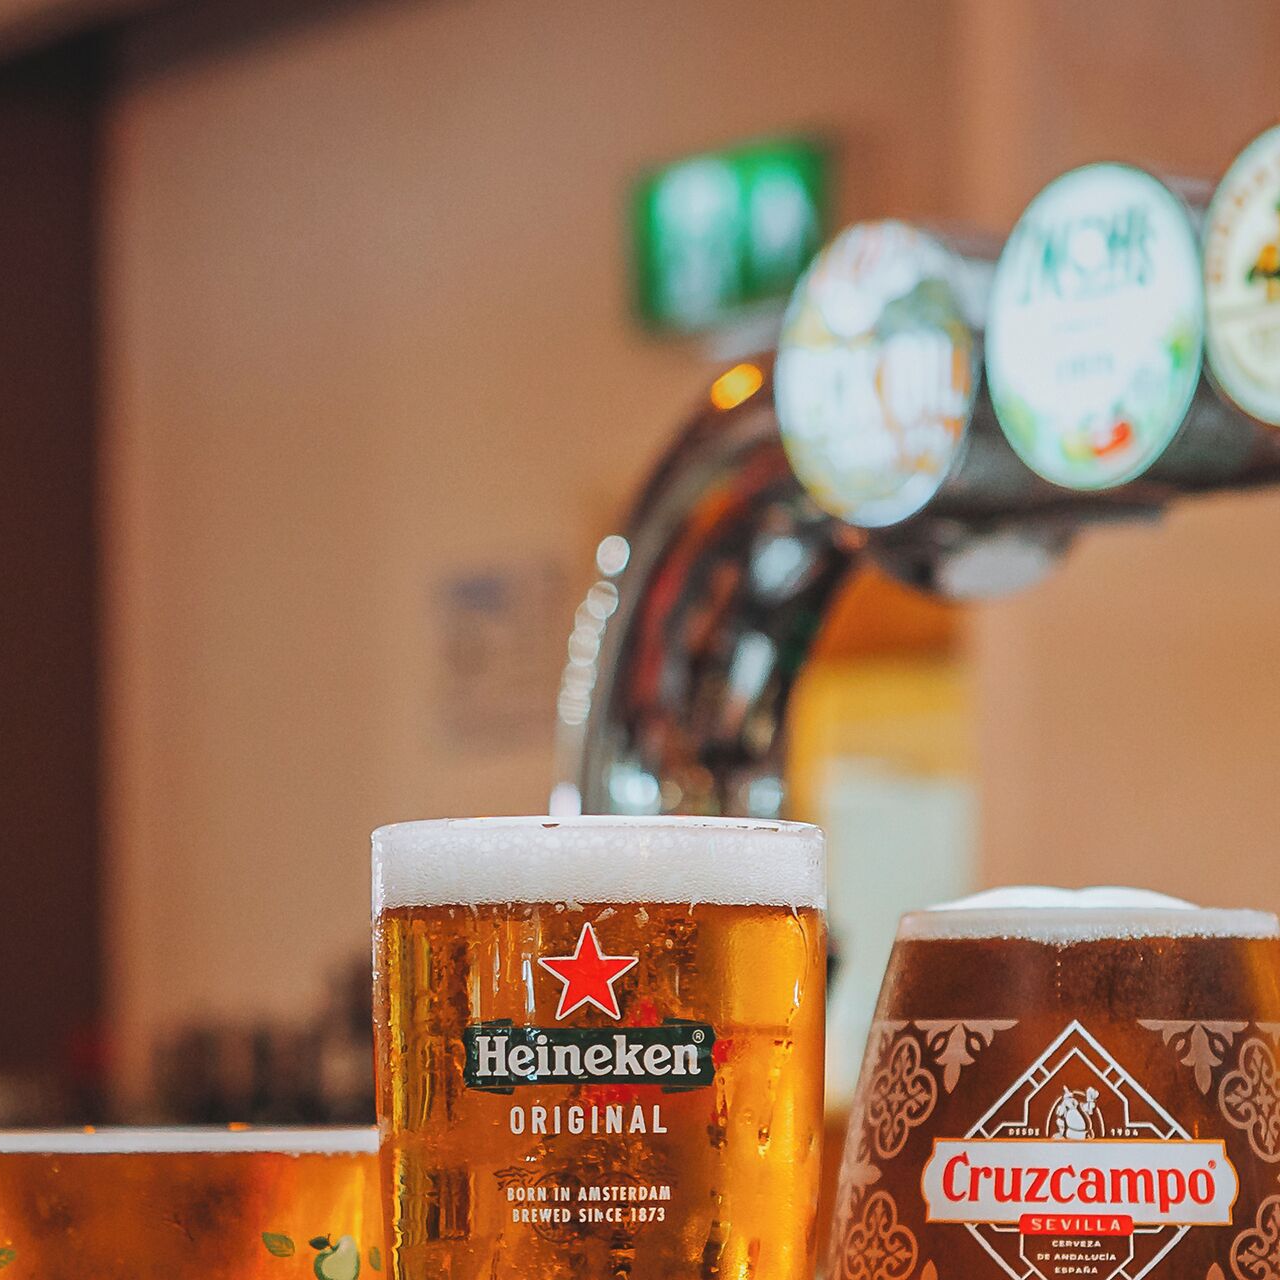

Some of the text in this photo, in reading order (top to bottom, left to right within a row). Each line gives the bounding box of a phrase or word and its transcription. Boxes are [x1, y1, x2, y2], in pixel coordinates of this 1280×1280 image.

[475, 1034, 701, 1077] Heineken
[509, 1104, 668, 1135] ORIGINAL
[942, 1151, 1215, 1214] Cruzcampo
[506, 1185, 671, 1201] BORN IN AMSTERDAM
[512, 1207, 665, 1223] BREWED SINCE 1873
[1031, 1217, 1121, 1232] SEVILLA
[1051, 1239, 1101, 1248] CERVEZA
[1037, 1251, 1117, 1261] DE ANDALUCÍA
[1054, 1265, 1099, 1274] ESPAÑA
